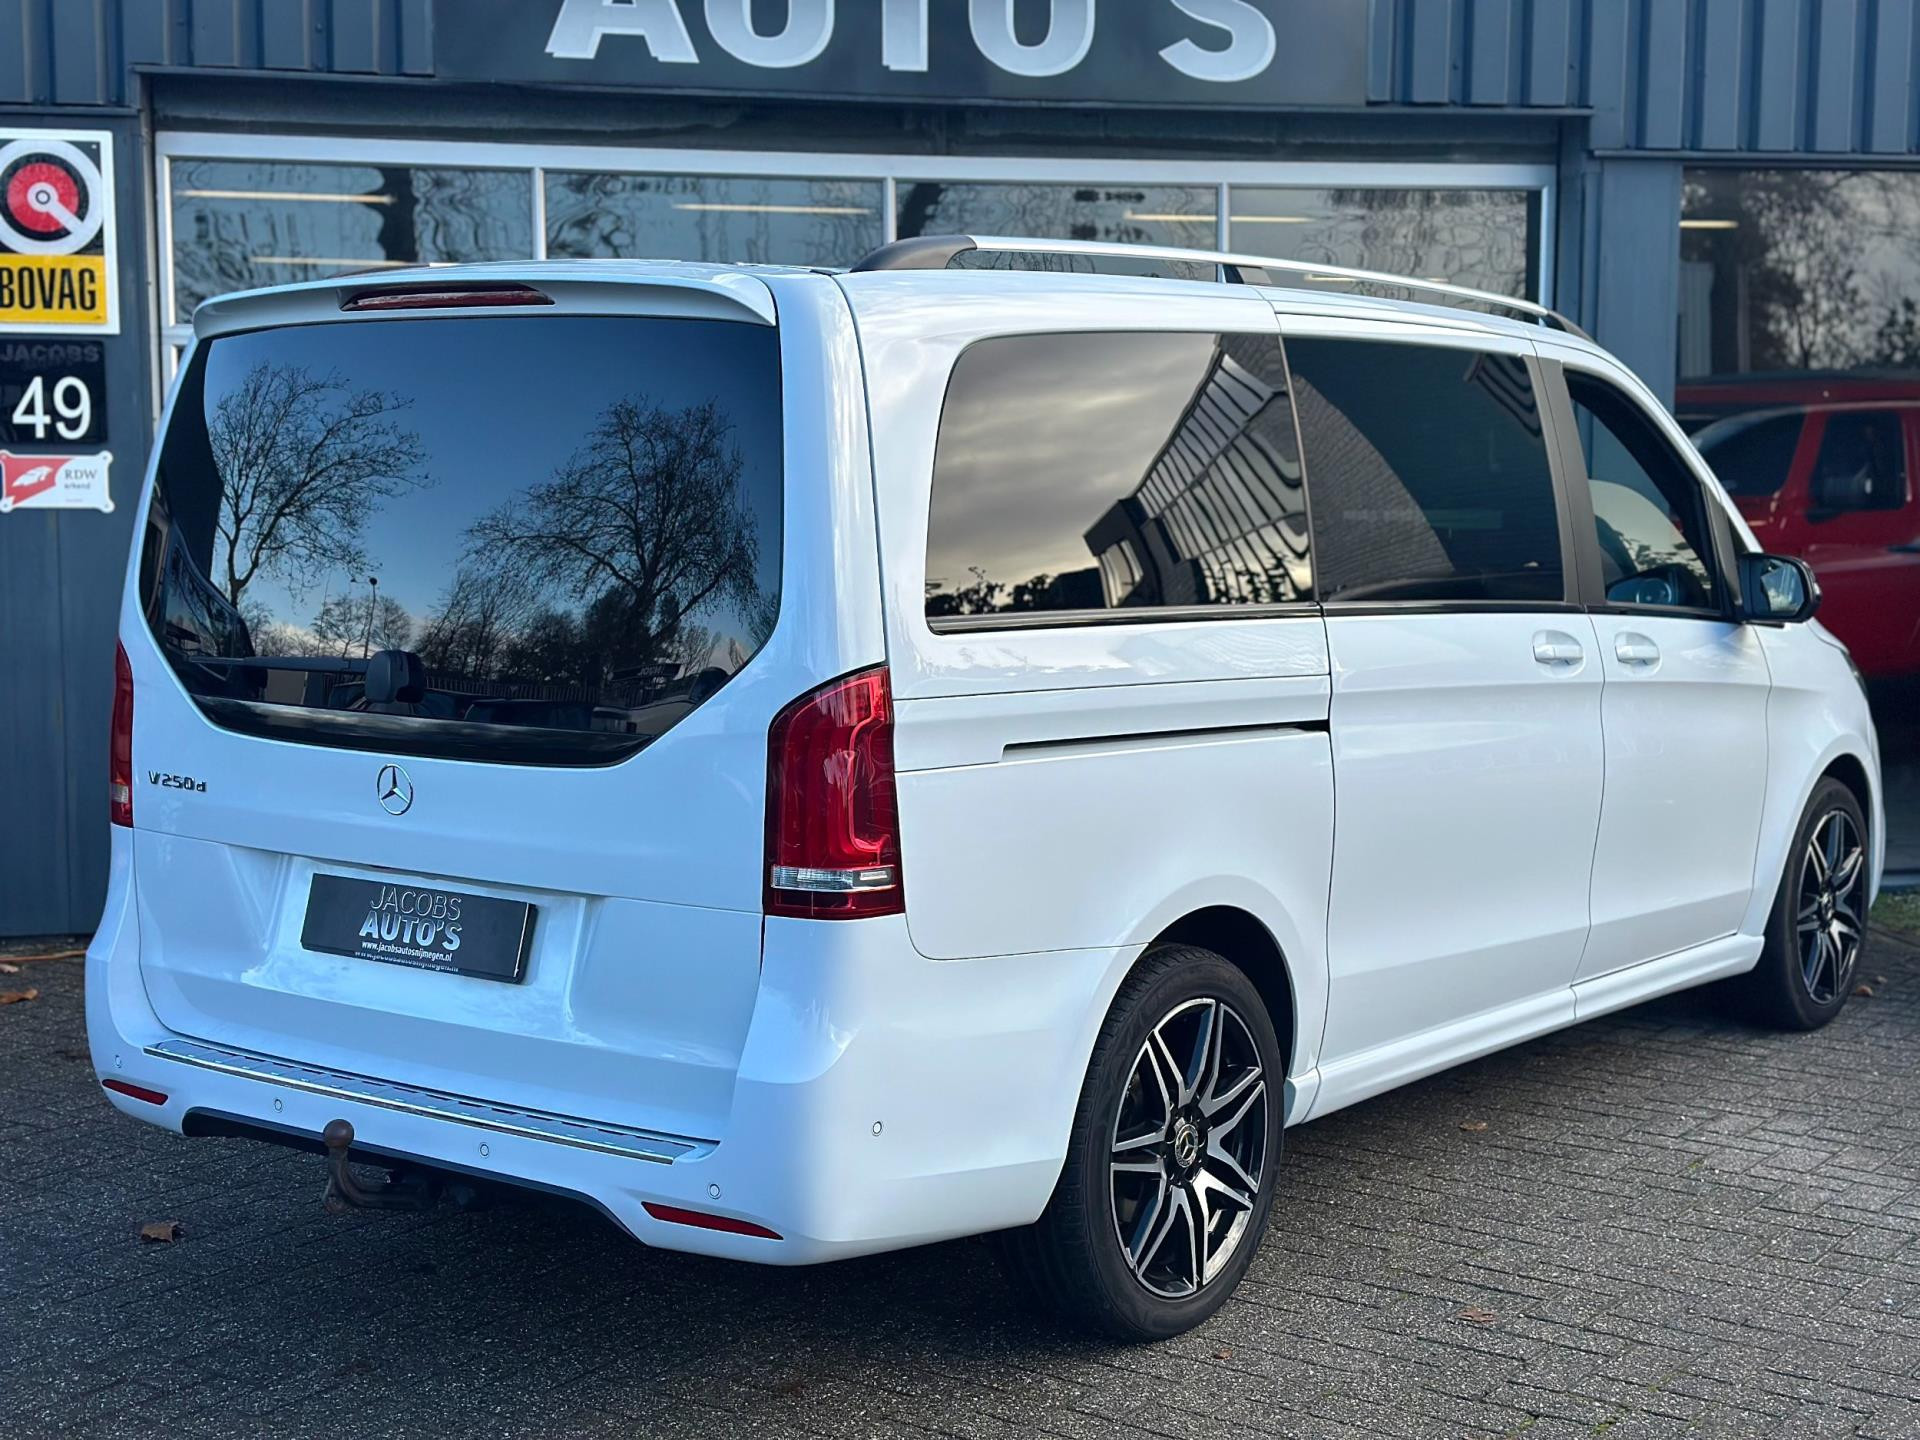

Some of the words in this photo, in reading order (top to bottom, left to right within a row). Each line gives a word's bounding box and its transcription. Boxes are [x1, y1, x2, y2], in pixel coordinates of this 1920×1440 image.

[0, 267, 97, 311] BOVAG
[0, 344, 100, 363] JACOBS
[12, 375, 91, 440] 49
[64, 469, 98, 480] RDW
[370, 885, 462, 921] JACOBS
[359, 910, 462, 950] AUTO'S
[361, 941, 453, 961] www.jacobsautosnijmegen.nl
